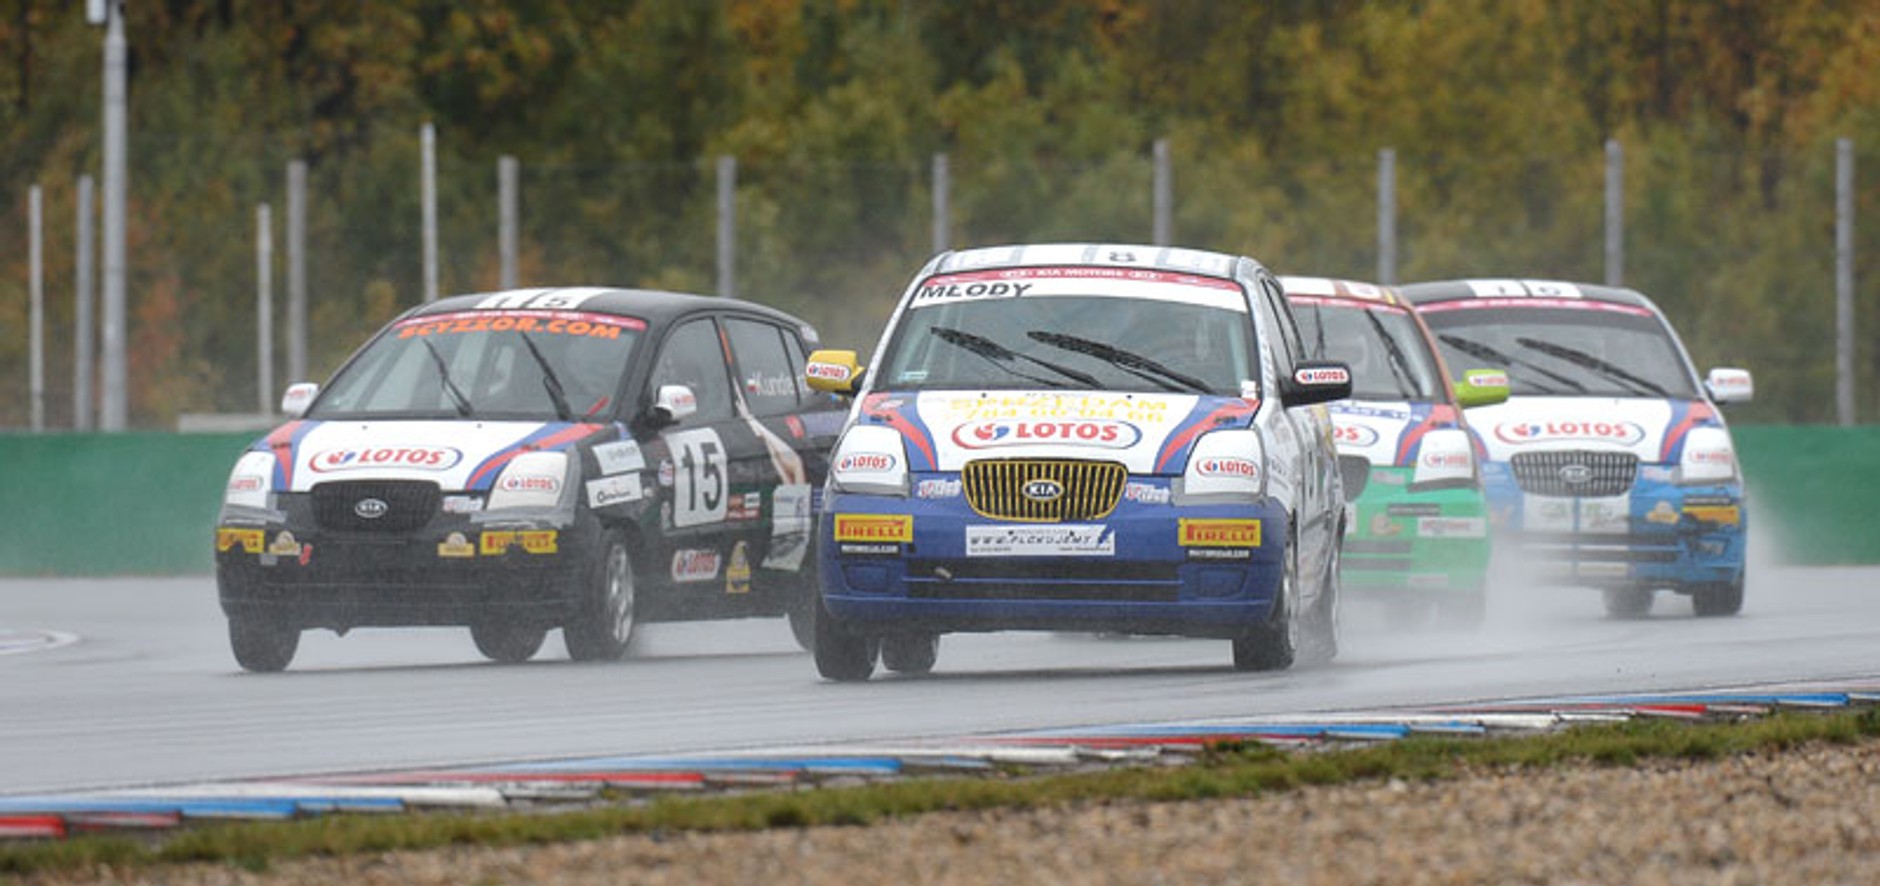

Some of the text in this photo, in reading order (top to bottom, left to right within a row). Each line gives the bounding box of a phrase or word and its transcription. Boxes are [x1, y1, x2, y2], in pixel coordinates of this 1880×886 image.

[920, 282, 1033, 299] MŁODY
[397, 317, 622, 340] SCYZZOR.COM
[818, 366, 846, 379] LOTOS
[1313, 370, 1346, 381] LOTOS
[1016, 422, 1119, 442] LOTOS
[1546, 422, 1627, 437] LOTOS
[359, 448, 445, 465] LOTOS
[852, 455, 888, 470] LOTOS
[682, 442, 722, 512] 15
[1219, 460, 1255, 477] LOTOS
[520, 477, 555, 491] LOTOS
[1029, 485, 1056, 497] KIA
[838, 519, 906, 538] PIRELLI
[1185, 524, 1257, 541] PIRELLI
